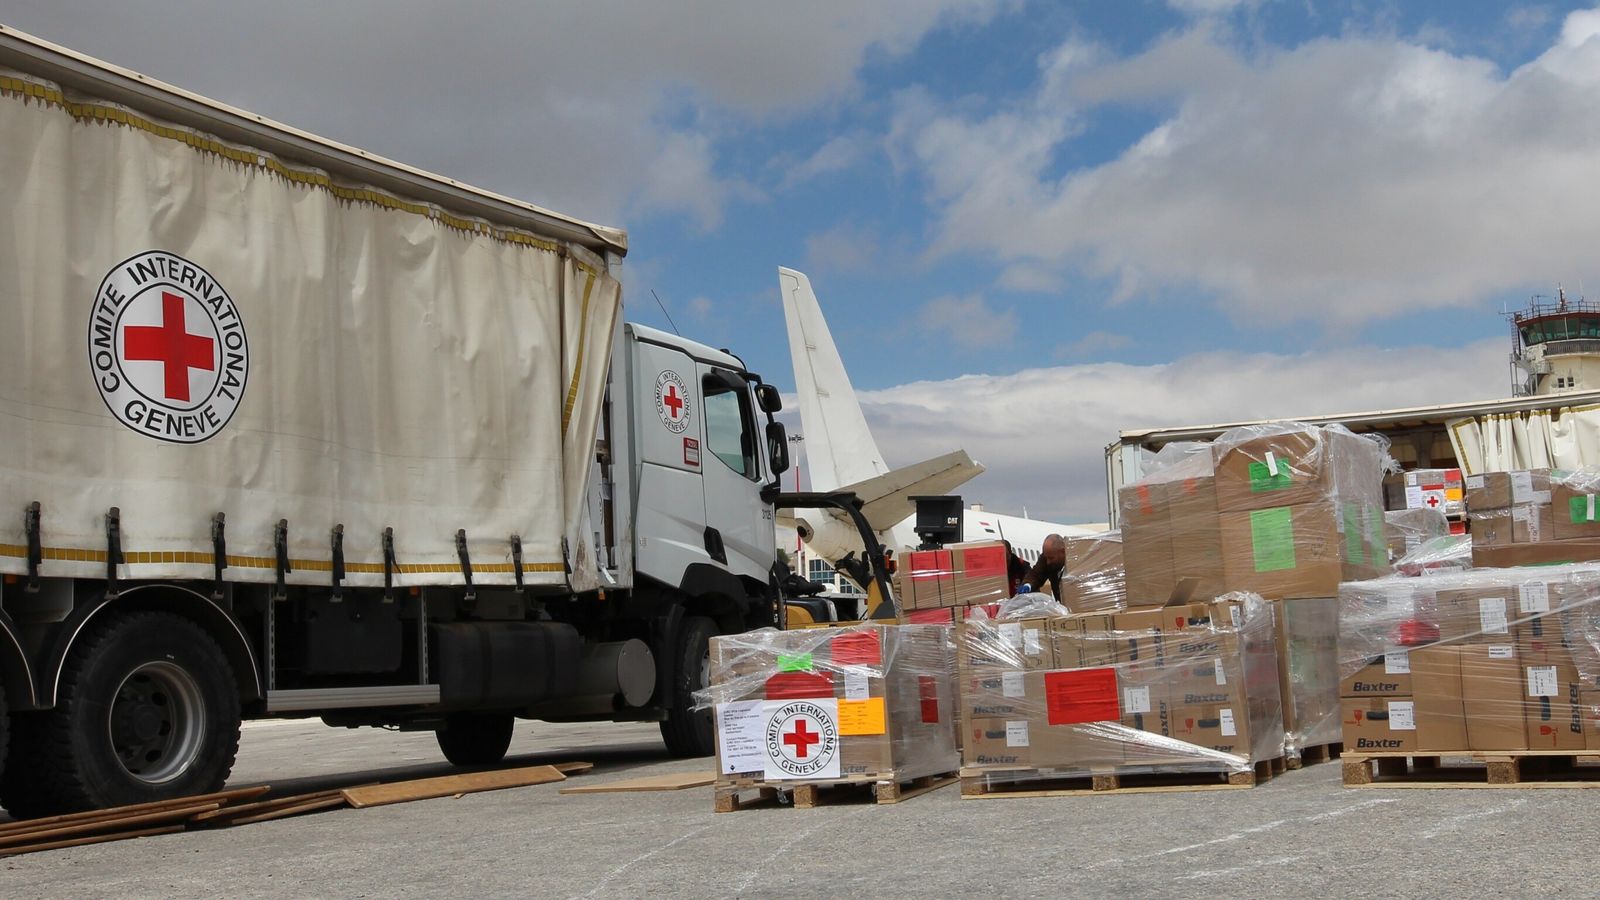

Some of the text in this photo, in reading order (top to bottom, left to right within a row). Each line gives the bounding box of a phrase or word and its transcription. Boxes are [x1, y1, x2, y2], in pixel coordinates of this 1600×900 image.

[92, 257, 245, 402] COMITE INTERNATIONAL
[662, 372, 690, 419] INTERNATIONAL
[124, 400, 222, 437] GENEVE
[664, 417, 686, 431] GENEVE
[947, 516, 958, 524] CAT
[1353, 681, 1399, 692] Baxter
[1184, 692, 1229, 704] Baxter
[973, 706, 1013, 714] Baxter
[1569, 682, 1582, 734] Baxter
[1160, 700, 1169, 736] axter
[768, 717, 782, 758] COMITE
[783, 704, 835, 757] INTERNATIONAL
[1357, 737, 1404, 748] Baxter
[781, 759, 823, 774] GENEVE
[976, 755, 1018, 764] Baxter
